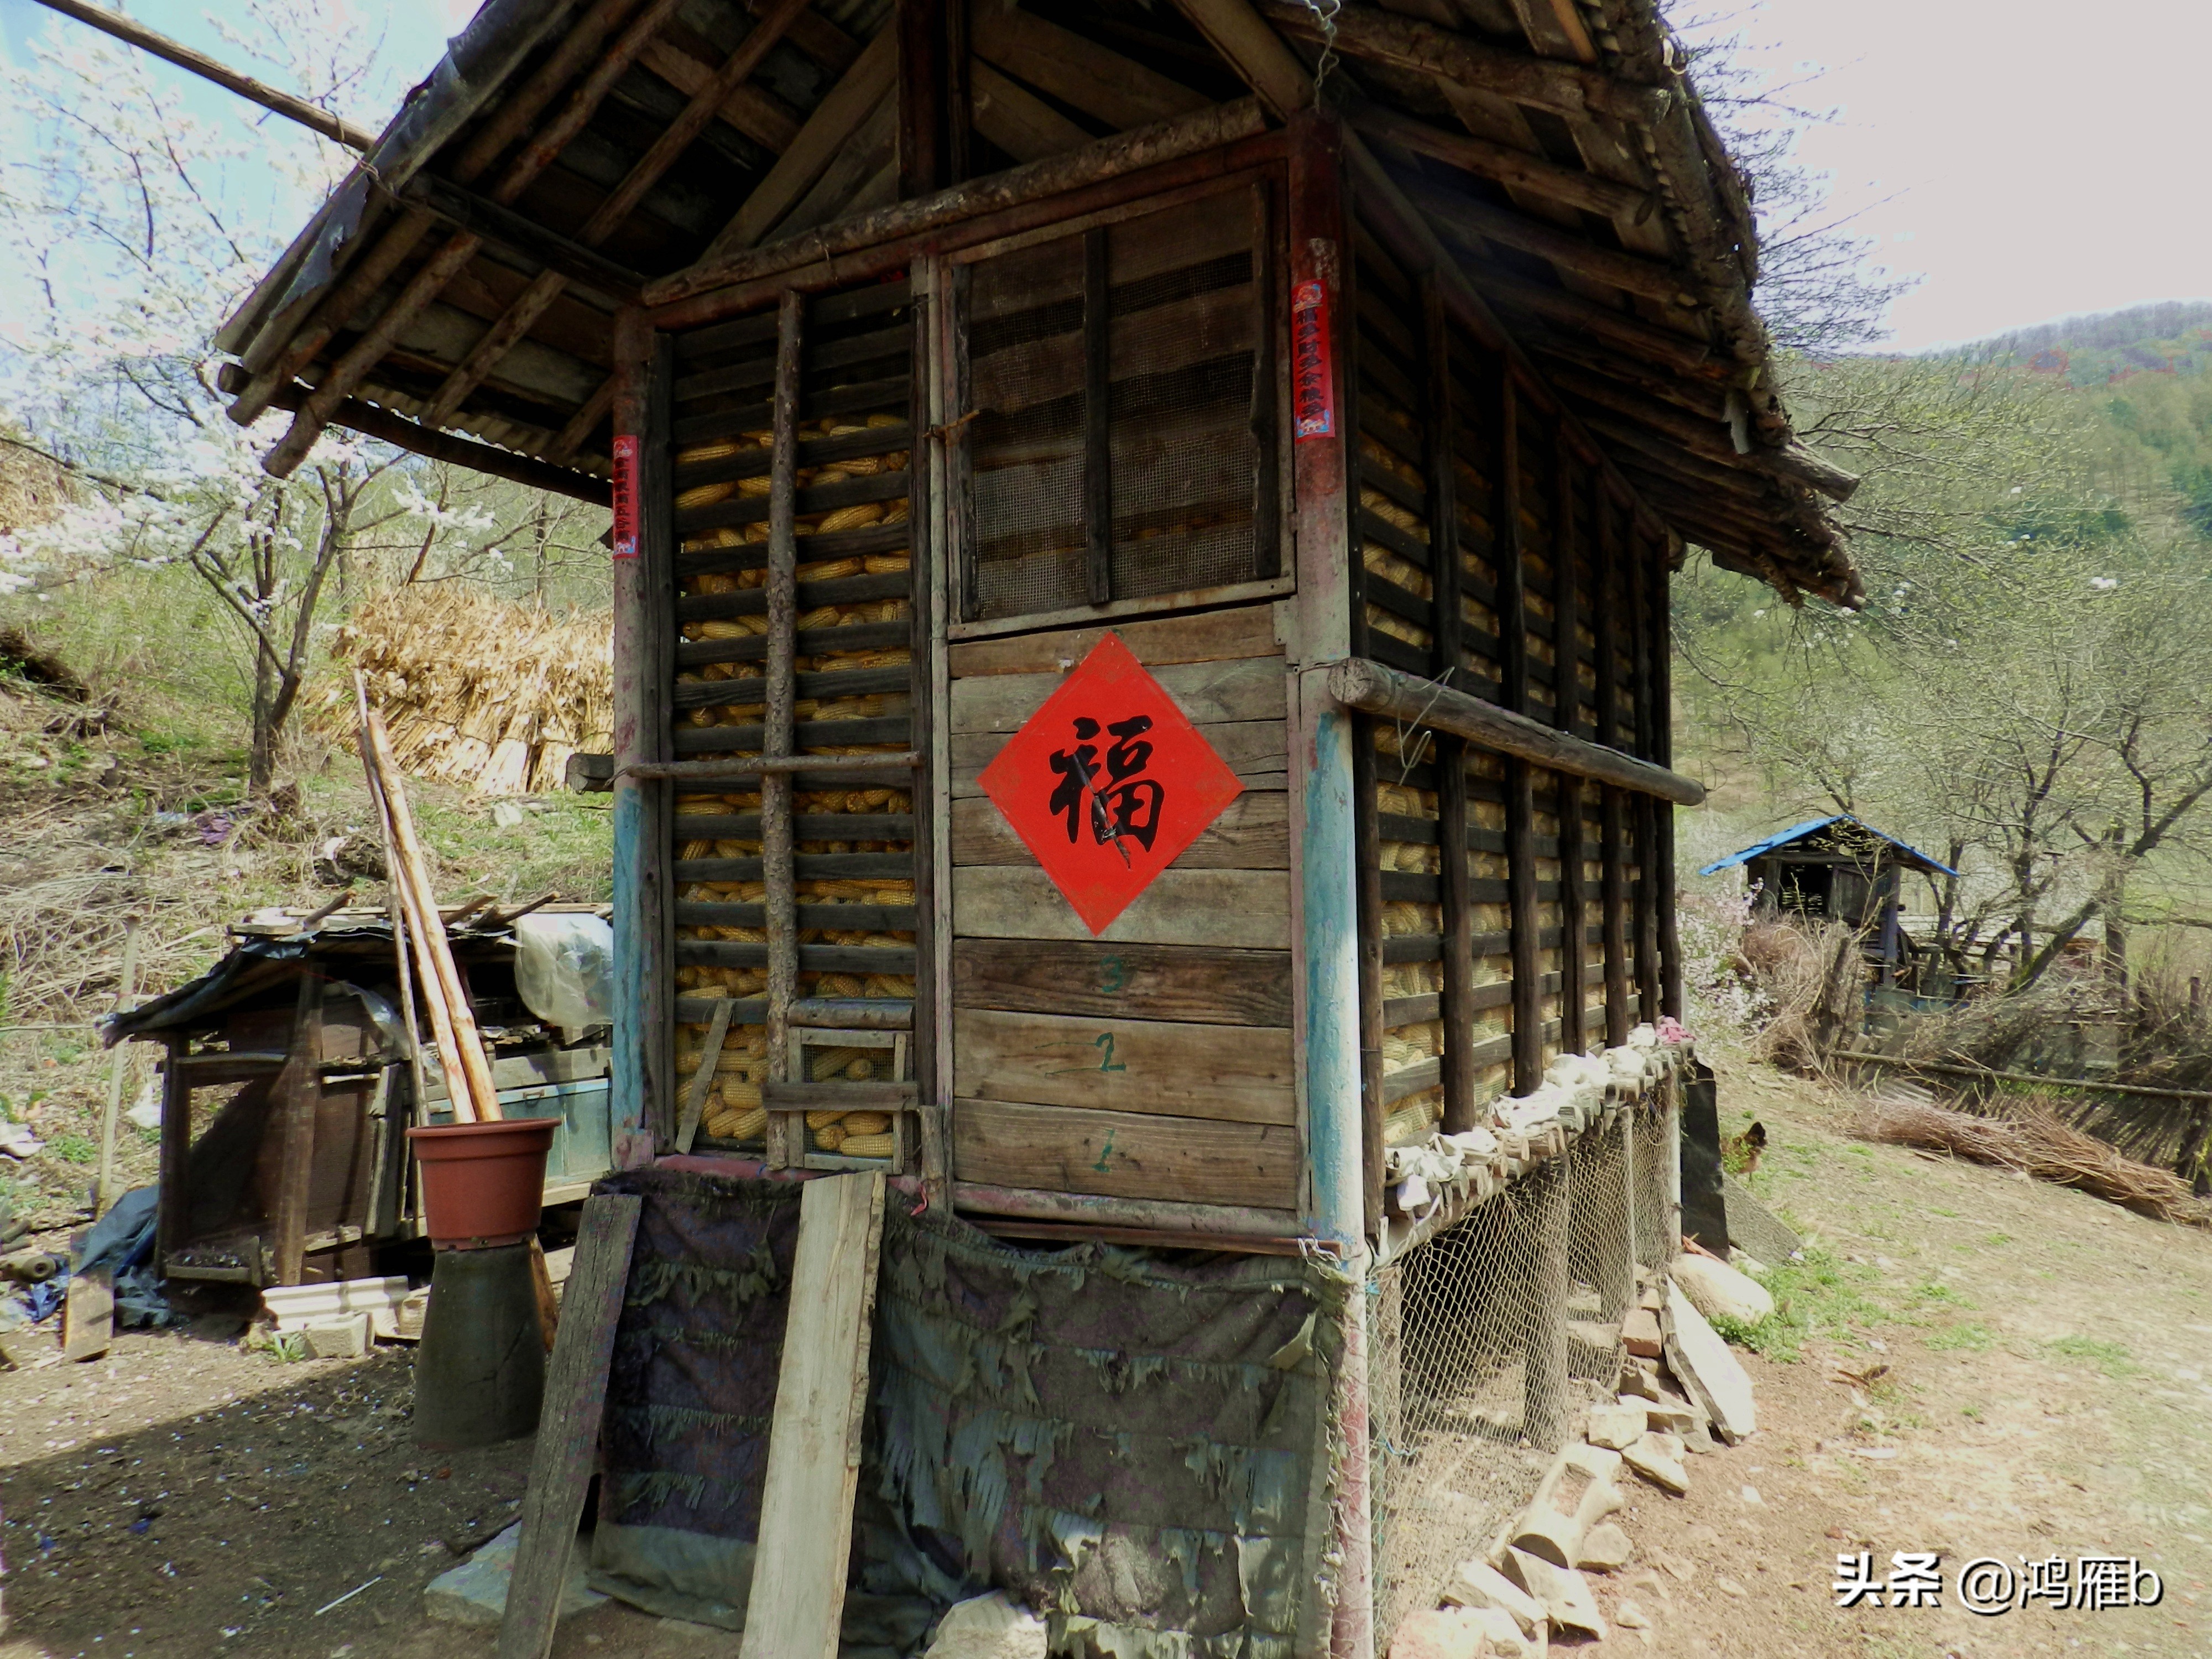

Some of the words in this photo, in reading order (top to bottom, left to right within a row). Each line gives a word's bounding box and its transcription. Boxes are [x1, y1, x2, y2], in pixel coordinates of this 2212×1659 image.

[1049, 714, 1165, 853] 福
[1100, 953, 1124, 994] 3
[1094, 1031, 1127, 1072] 2
